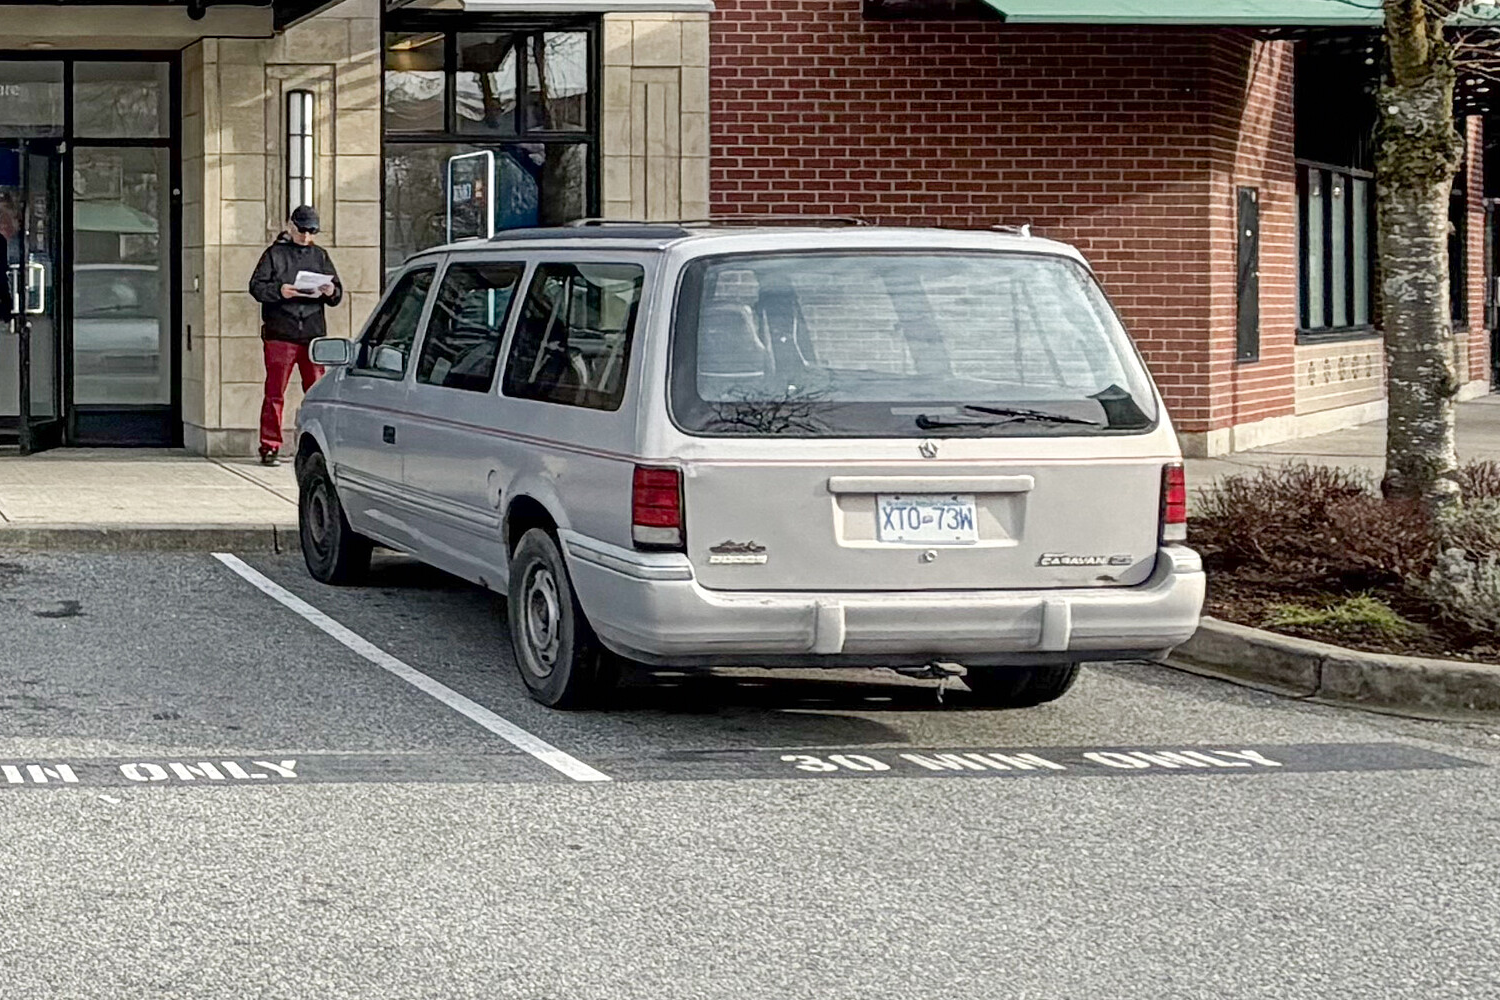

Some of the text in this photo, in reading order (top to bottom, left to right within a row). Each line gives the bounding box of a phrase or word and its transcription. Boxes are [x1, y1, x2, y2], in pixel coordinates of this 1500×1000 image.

[119, 760, 298, 782] ONLY
[781, 749, 1283, 772] 30 MIN ONLY
